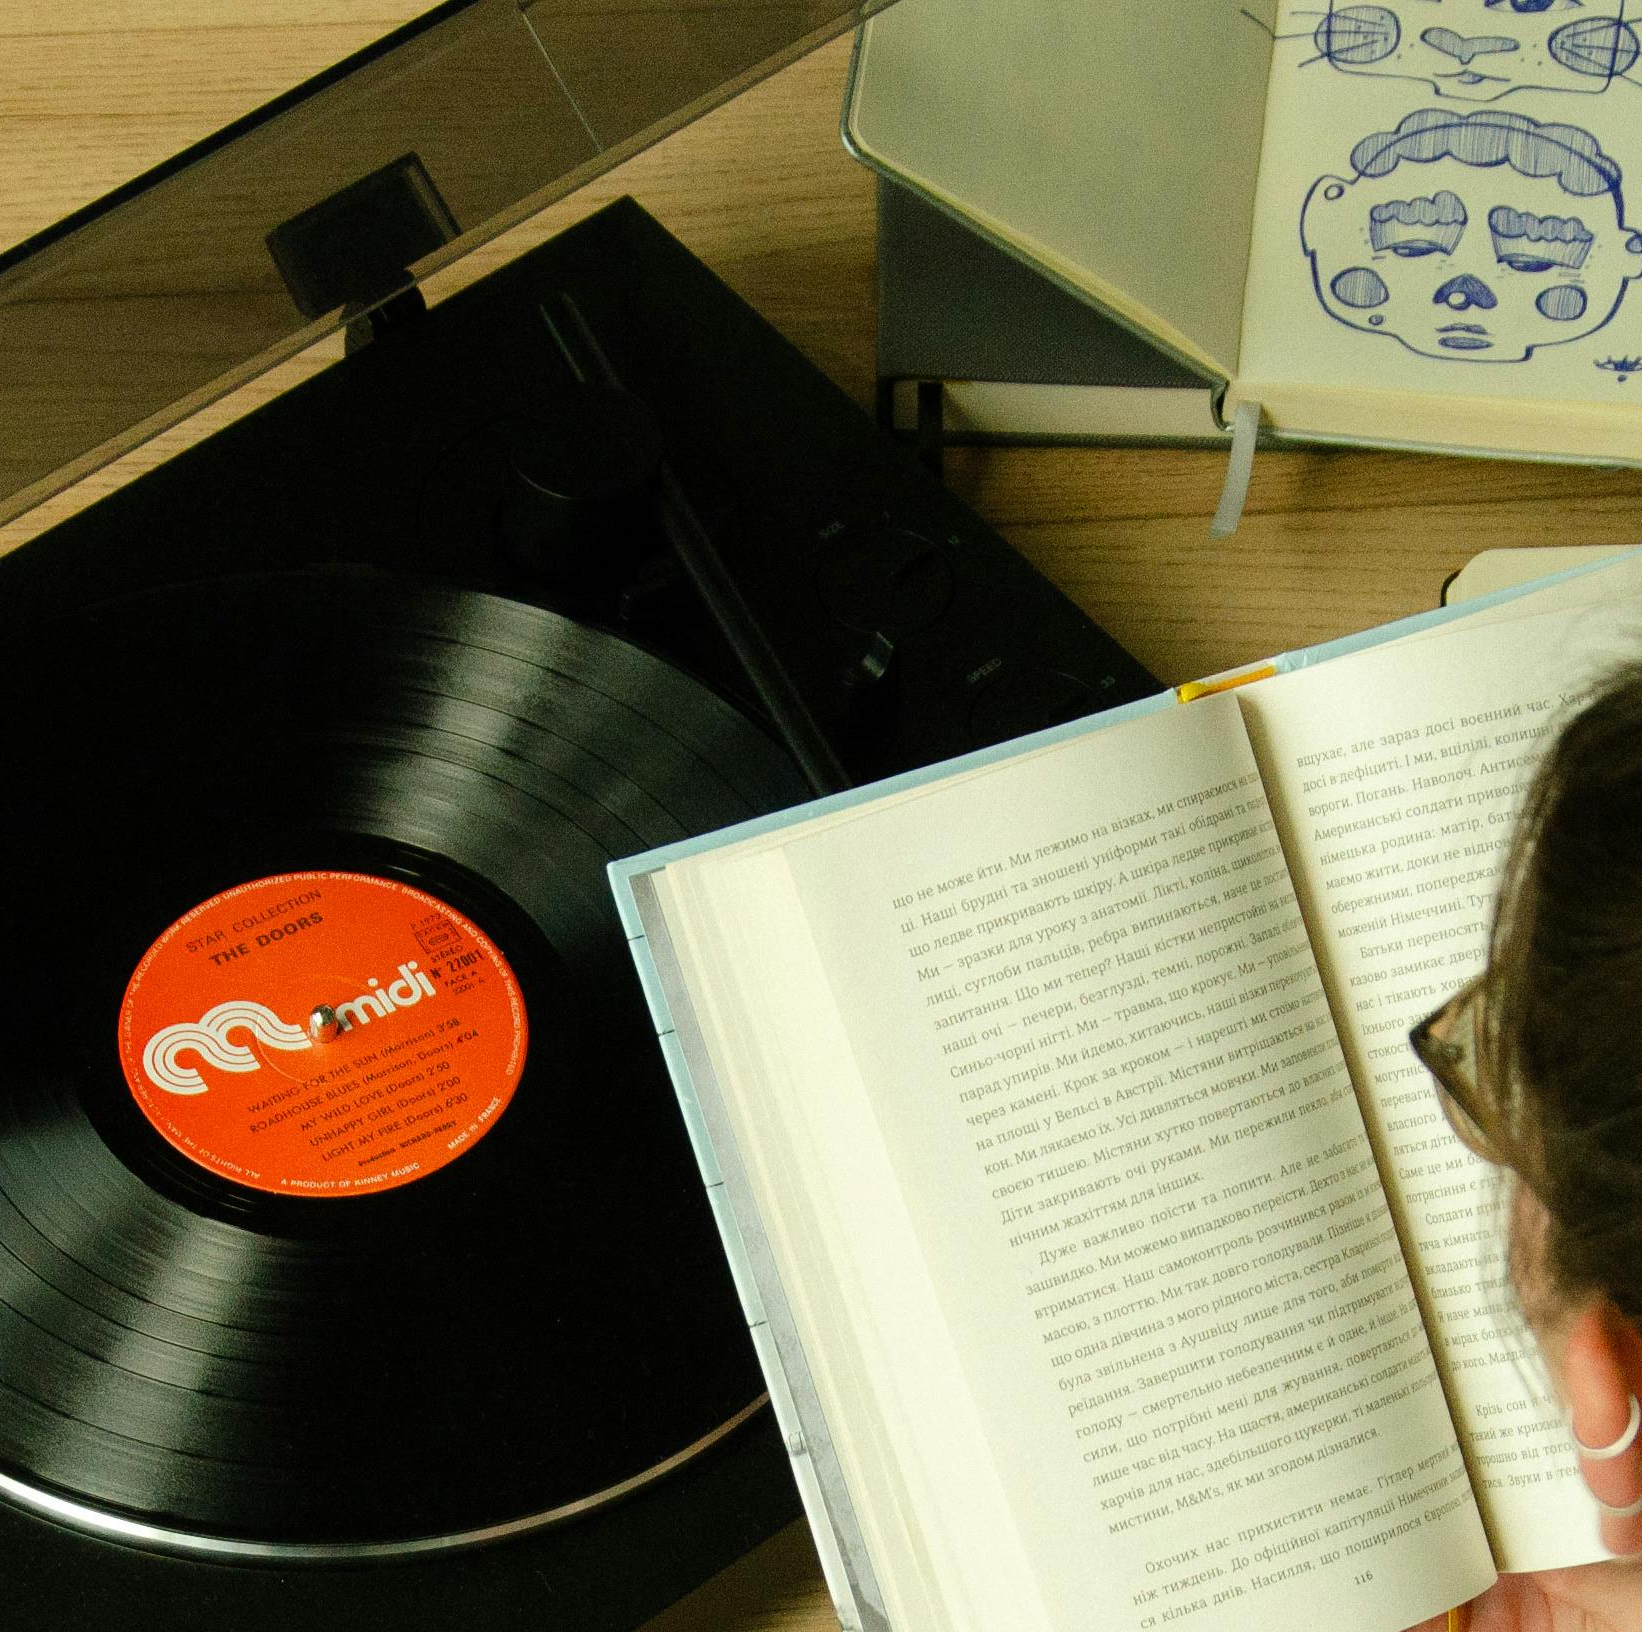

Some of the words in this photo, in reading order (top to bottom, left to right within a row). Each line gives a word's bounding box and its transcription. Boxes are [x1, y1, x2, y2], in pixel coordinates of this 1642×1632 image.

[1295, 746, 1346, 768] вщухає,
[1350, 739, 1374, 753] але
[1379, 728, 1420, 746] зараз
[1424, 716, 1455, 737] досі
[1459, 703, 1522, 728] воєнний
[1525, 698, 1554, 712] час.
[1302, 774, 1327, 794] досі
[1328, 775, 1337, 785] в
[1339, 759, 1402, 784] дефіциті.
[1413, 750, 1437, 764] ми,
[1439, 735, 1491, 758] вцілілі,
[1307, 797, 1349, 816] вороги.
[1355, 784, 1405, 804] Погань.
[1411, 767, 1476, 791] Наволоч.
[1313, 810, 1402, 842] Американські
[1404, 795, 1463, 818] солдати
[891, 894, 914, 909] що
[915, 886, 933, 901] не
[936, 872, 974, 894] може
[976, 862, 1003, 880] йти.
[1008, 851, 1032, 868] Ми
[1034, 832, 1089, 859] лежимо
[1090, 825, 1109, 839] на
[1110, 809, 1155, 832] візках,
[1155, 801, 1175, 817] ми
[900, 920, 915, 933] ці.
[919, 902, 957, 926] Наші
[960, 887, 1008, 912] брудні
[1010, 881, 1028, 894] та
[1031, 856, 1089, 887] зношені
[1091, 834, 1158, 869] уніформи
[1159, 821, 1186, 842] такі
[1187, 803, 1235, 832] обідрані
[186, 930, 227, 953] STAR
[232, 889, 322, 933] COLLECTION
[908, 942, 931, 958] що
[933, 927, 973, 949] ледве
[975, 894, 1071, 934] прикривають
[1072, 877, 1116, 900] шкіру.
[1118, 870, 1129, 885] А
[1129, 858, 1170, 880] шкіра
[1171, 844, 1206, 866] ледве
[209, 943, 252, 967] THE
[256, 912, 324, 948] DOORS
[926, 984, 961, 1006] лиці,
[964, 964, 1022, 993] суглоби
[1025, 943, 1085, 971] пальців,
[1086, 926, 1128, 953] ребра
[1130, 894, 1221, 934] випинаються,
[1221, 883, 1248, 901] наче
[1248, 878, 1262, 892] це
[933, 996, 1009, 1030] запитання.
[1014, 985, 1039, 1002] Що
[1042, 976, 1063, 992] ми
[1064, 957, 1111, 983] тепер?
[1114, 942, 1151, 967] Наші
[1153, 929, 1196, 953] кістки
[1197, 900, 1268, 937] непристойні
[333, 960, 438, 1033] midi
[304, 1075, 327, 1091] FOR
[331, 1065, 352, 1082] THE
[355, 1052, 378, 1069] SUN
[249, 1095, 324, 1134] ROADHOUSE
[325, 1079, 360, 1100] BLUES
[300, 1117, 318, 1132] MY
[320, 1105, 351, 1122] WILD
[354, 1090, 384, 1108] LOVE
[386, 1073, 425, 1095] (Doors)
[310, 1119, 366, 1147] UNHAPPY
[367, 1105, 395, 1123] GIRL
[397, 1089, 436, 1112] (Doors)
[445, 1130, 470, 1150] MADE
[476, 1096, 501, 1124] FRANCE
[322, 1140, 356, 1163] LIGHT
[358, 1133, 377, 1149] MY
[378, 1121, 403, 1137] FIRE
[405, 1106, 444, 1128] (Doors)
[290, 1179, 336, 1187] PRODUCT
[338, 1180, 352, 1188] OF
[389, 1161, 420, 1178] MUSIC
[1000, 1203, 1033, 1225] Діти
[1036, 1174, 1121, 1210] закривають
[1124, 1163, 1147, 1179] очі
[1149, 1143, 1206, 1174] руками.
[1207, 1133, 1231, 1150] Ми
[1233, 1108, 1297, 1141] пережили
[1008, 1221, 1060, 1247] нічним
[1061, 1197, 1128, 1229] жахіттям
[1129, 1187, 1155, 1206] для
[1156, 1171, 1204, 1195] інших.
[1108, 1504, 1174, 1534] мистини,
[1225, 1478, 1243, 1492] як
[1244, 1470, 1265, 1486] ми
[1266, 1452, 1315, 1477] згодом
[1316, 1427, 1380, 1461] дізналися.
[1144, 1547, 1199, 1574] Охочих
[1205, 1536, 1230, 1553] нас
[1236, 1502, 1324, 1542] прихистити
[1328, 1484, 1373, 1508] немає.
[1375, 1465, 1414, 1489] Гітлер
[1353, 1569, 1373, 1586] 116
